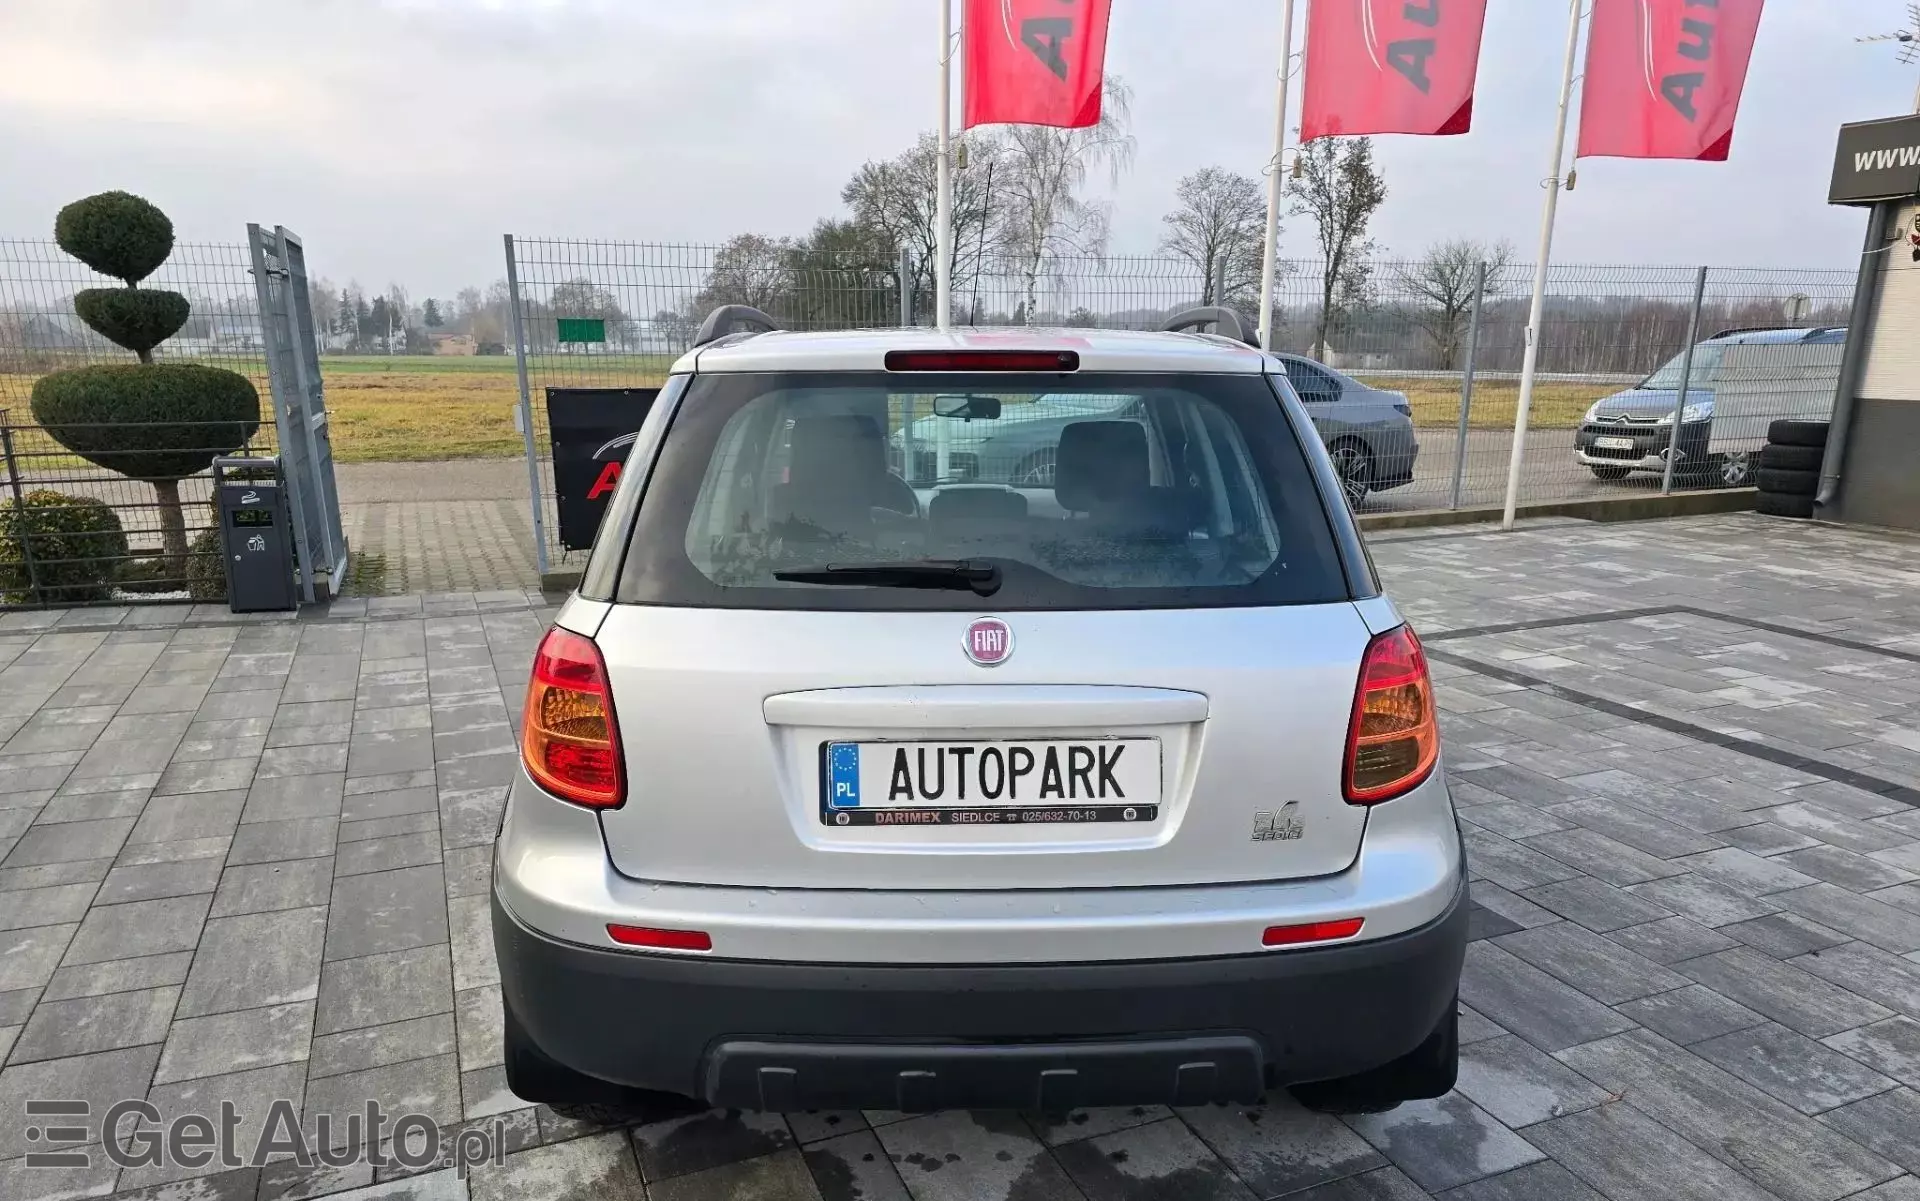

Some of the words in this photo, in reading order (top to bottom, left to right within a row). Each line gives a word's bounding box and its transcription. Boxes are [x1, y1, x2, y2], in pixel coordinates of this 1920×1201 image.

[1020, 0, 1075, 84] A
[1660, 0, 1719, 123] Au
[974, 629, 1004, 652] FIAT
[836, 782, 856, 797] PL
[888, 744, 1126, 801] AUTOPARK
[875, 811, 941, 824] DARIMEX
[951, 812, 1000, 822] SIEDLCE
[1022, 810, 1097, 822] 025/632-70-13
